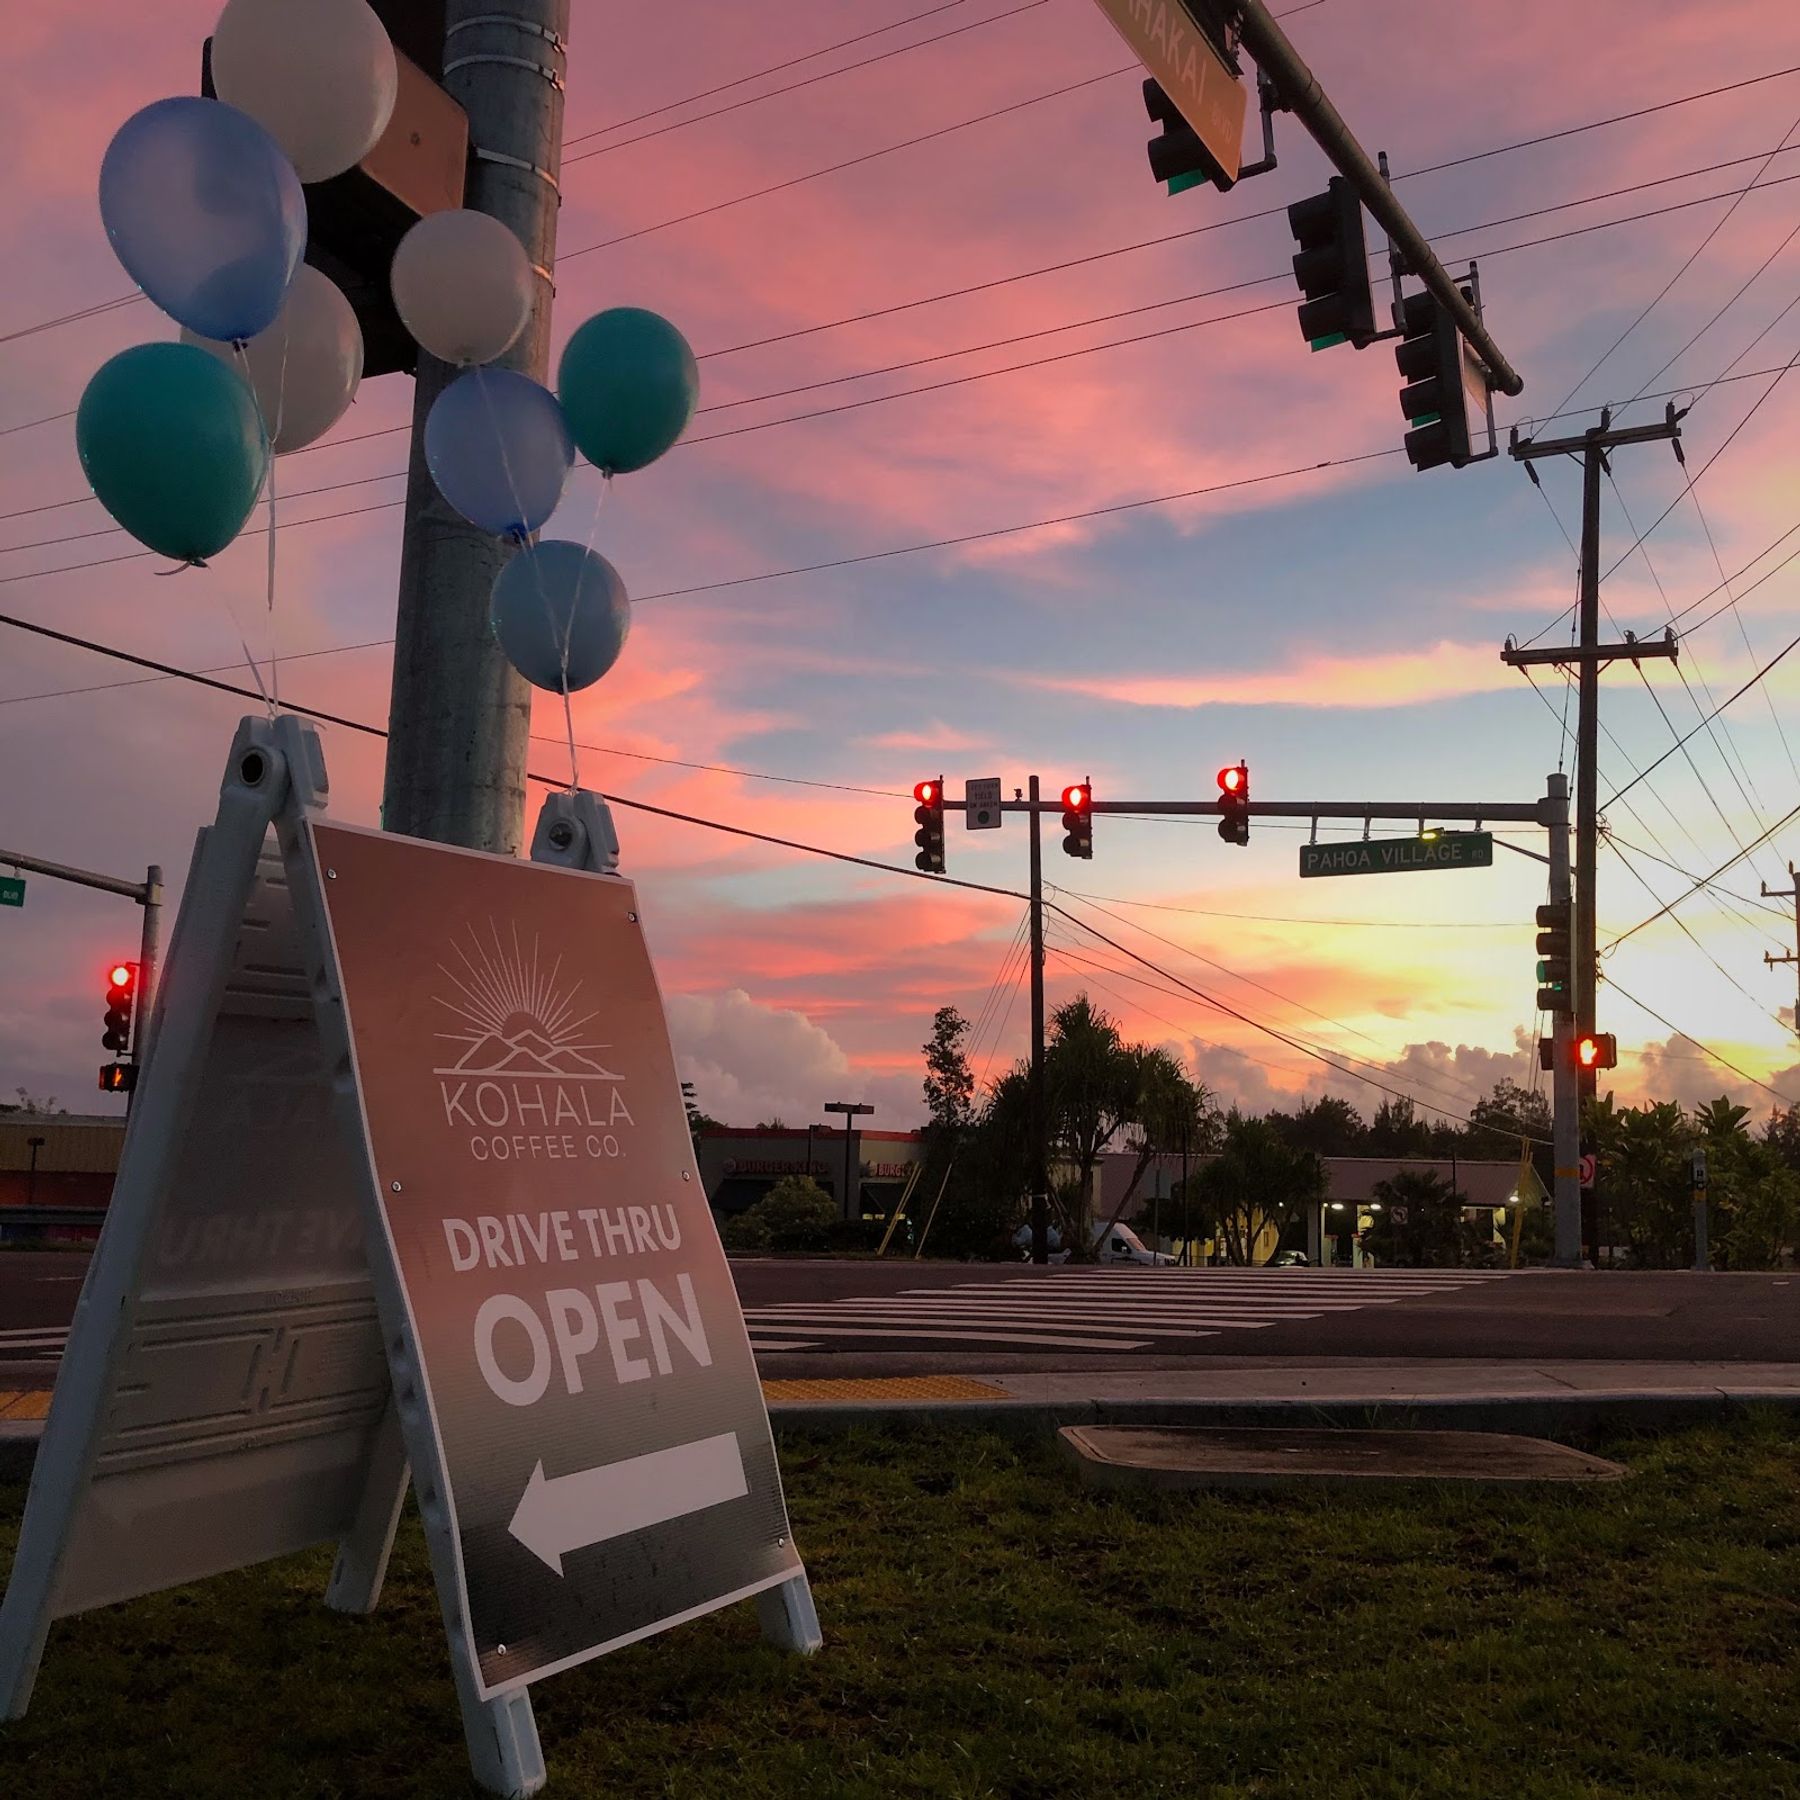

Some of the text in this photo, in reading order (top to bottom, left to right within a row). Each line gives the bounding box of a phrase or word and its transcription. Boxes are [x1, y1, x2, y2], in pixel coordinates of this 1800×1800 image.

[1128, 0, 1207, 105] HAKAI
[1307, 850, 1371, 869] PAHOA
[1381, 843, 1462, 865] VILLAGE
[440, 1081, 635, 1127] KOHALA
[471, 1134, 627, 1160] COFFEE CO.
[442, 1204, 682, 1272] DRIVE THRU
[473, 1272, 713, 1407] OPEN
